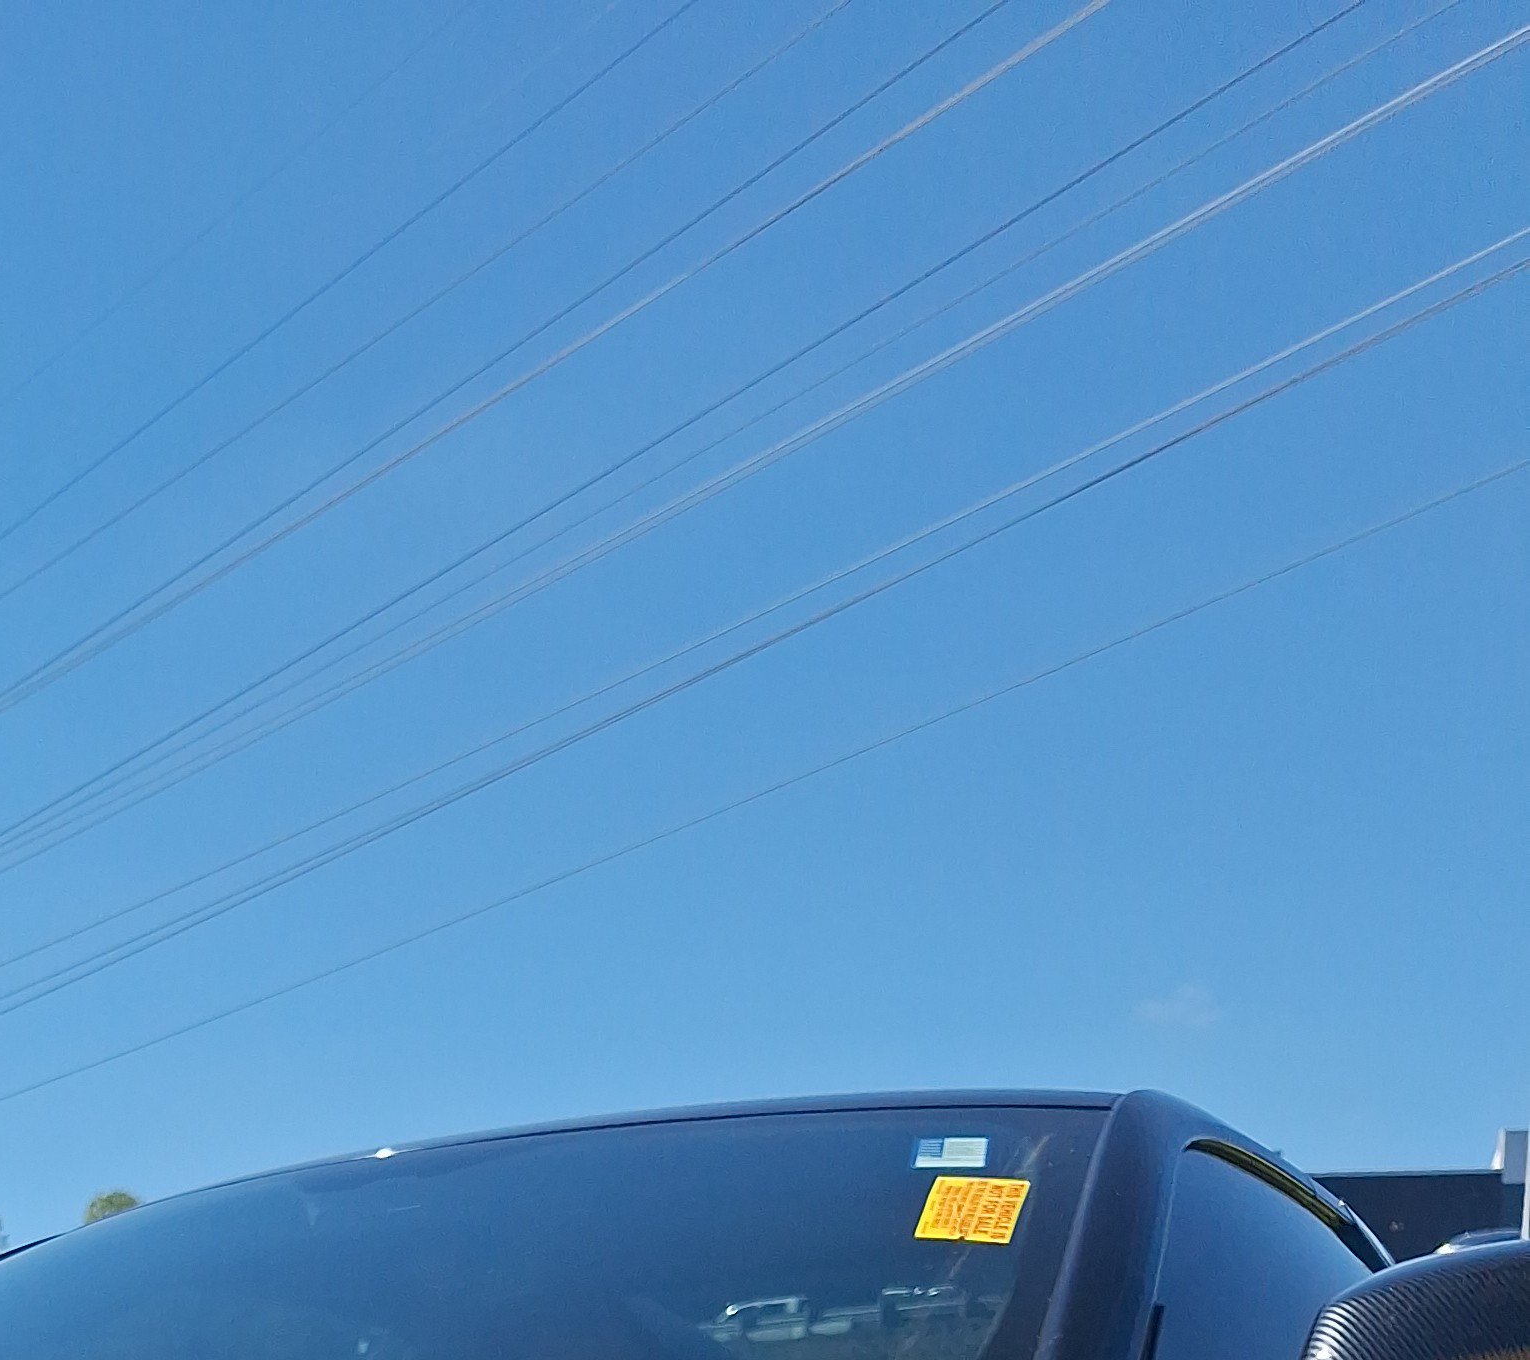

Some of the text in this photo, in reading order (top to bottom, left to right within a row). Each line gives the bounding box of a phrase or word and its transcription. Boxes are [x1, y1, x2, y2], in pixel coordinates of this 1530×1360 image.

[972, 1184, 1005, 1235] NOT FOR SALE
[993, 1200, 1018, 1230] VEHICLE
